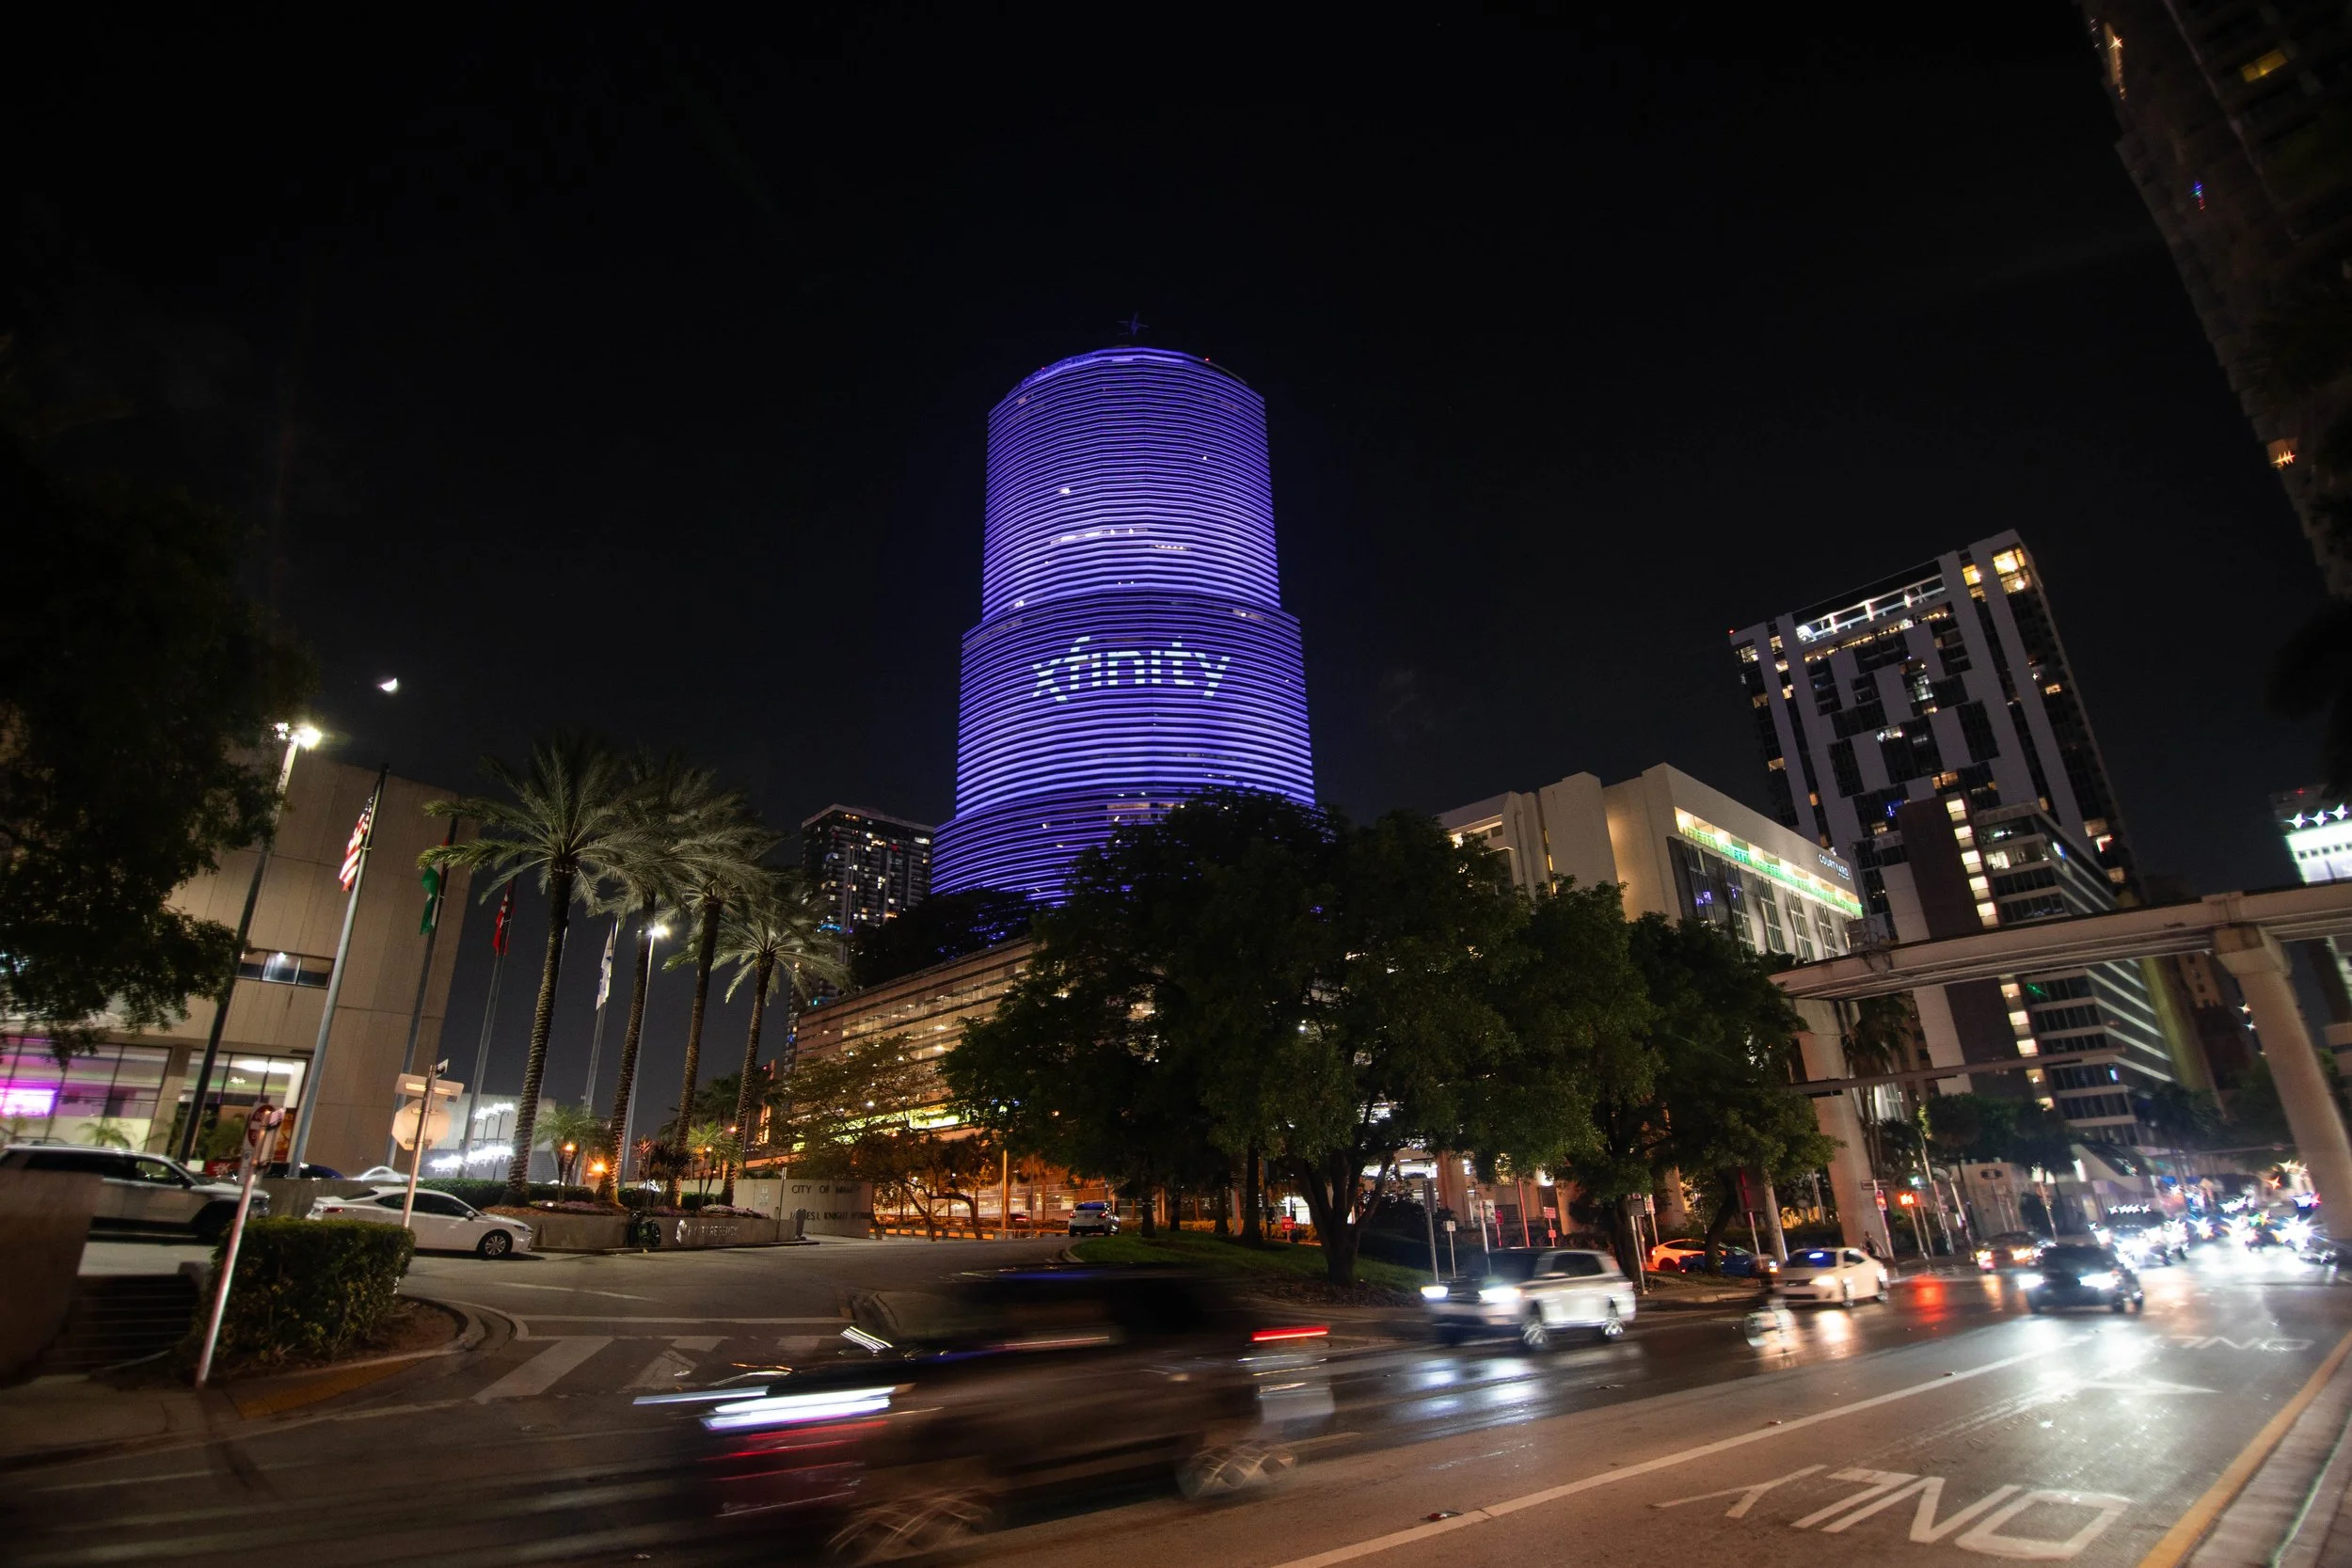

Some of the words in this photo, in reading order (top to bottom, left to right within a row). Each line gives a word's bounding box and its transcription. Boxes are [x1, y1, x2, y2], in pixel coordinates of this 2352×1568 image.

[1032, 636, 1231, 702] xfinity
[1819, 854, 1850, 876] COURTYARD
[791, 1184, 812, 1194] CITY
[819, 1185, 830, 1194] OF
[1653, 1465, 2137, 1560] ONLY
